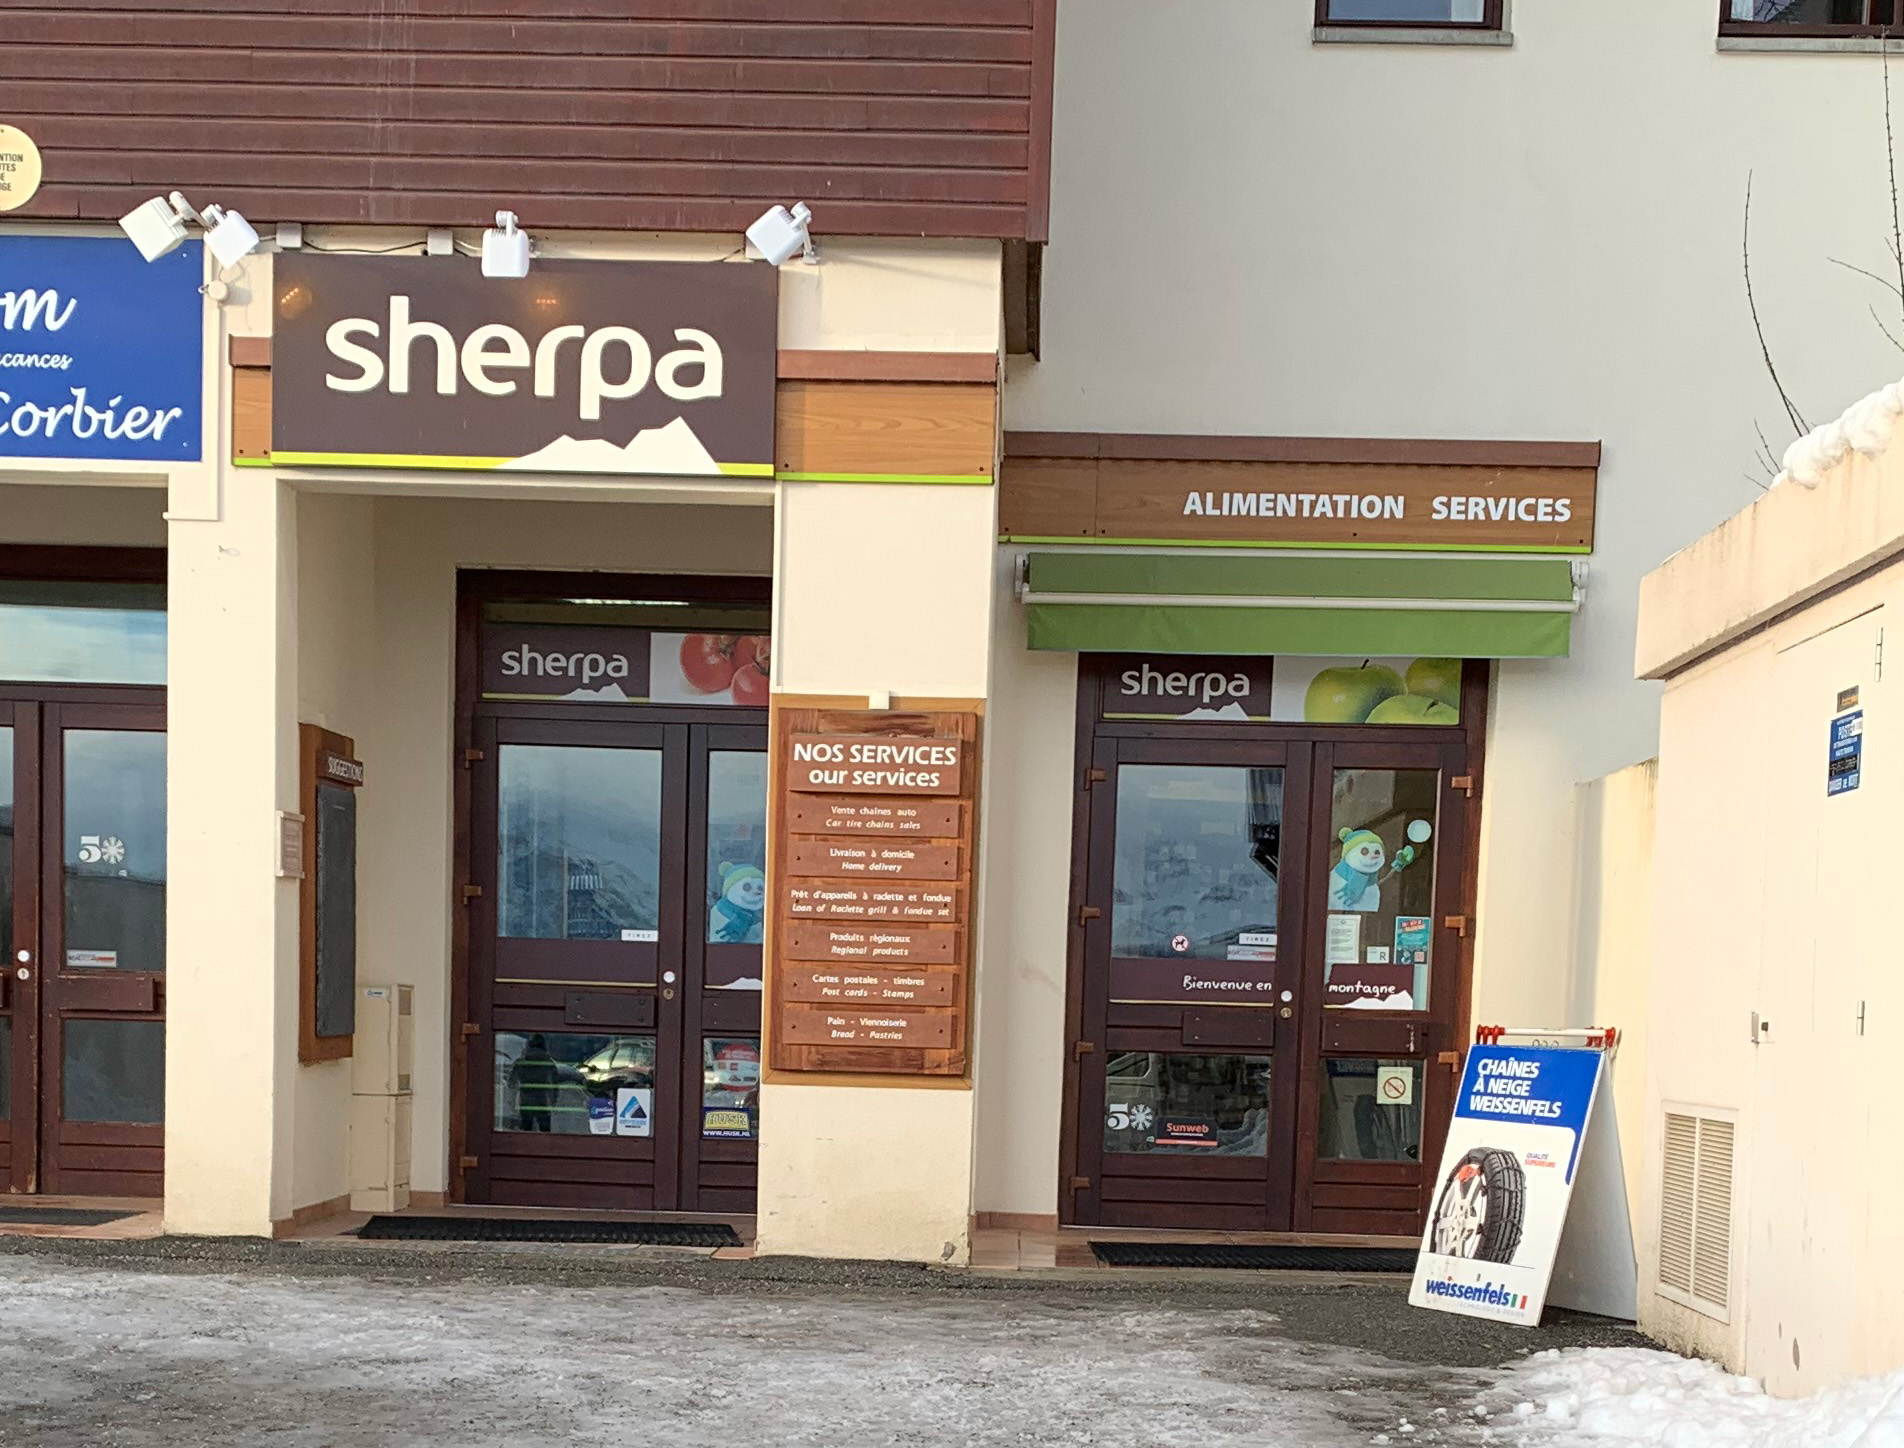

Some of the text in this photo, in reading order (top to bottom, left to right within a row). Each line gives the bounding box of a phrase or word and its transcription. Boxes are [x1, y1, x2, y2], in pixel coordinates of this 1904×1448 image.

[0, 163, 16, 172] TES
[325, 295, 724, 420] sherpa
[1183, 491, 1572, 523] ALIMENTATION SERVICES
[501, 643, 629, 684] sherpa
[1121, 663, 1251, 703] sherpa
[793, 743, 957, 766] NOS SERVICES
[809, 768, 941, 787] our services
[831, 806, 856, 815] Vente
[896, 808, 917, 817] auto
[825, 819, 921, 829] Car tire chains sales
[830, 848, 866, 857] Livraison
[881, 849, 915, 859] domicile
[841, 861, 903, 873] Home delivery
[907, 894, 918, 902] et
[922, 893, 952, 903] fondue
[792, 903, 813, 912] Loan
[816, 903, 827, 912] of
[830, 904, 865, 913] Raclette
[867, 906, 888, 916] grill
[904, 906, 934, 915] fondue
[937, 908, 950, 916] set
[829, 932, 865, 942] Produits
[831, 945, 909, 957] Regional products
[812, 974, 839, 983] Cartes
[844, 975, 878, 985] postales
[893, 976, 925, 986] timbres
[1182, 975, 1396, 997] Bienvenue en montagne
[821, 987, 840, 996] Post
[844, 988, 868, 997] cards
[882, 989, 915, 999] Stamps
[827, 1016, 846, 1025] Pain
[859, 1017, 908, 1027] Viennoiserie
[831, 1029, 856, 1039] Bread
[869, 1031, 903, 1040] Pastries
[1477, 1057, 1541, 1078] CHAÎNES
[1487, 1078, 1532, 1096] NEIGE
[1469, 1095, 1563, 1118] WEISSENFELS
[1166, 1122, 1210, 1134] Sunweb
[1425, 1275, 1511, 1306] weissenfels
